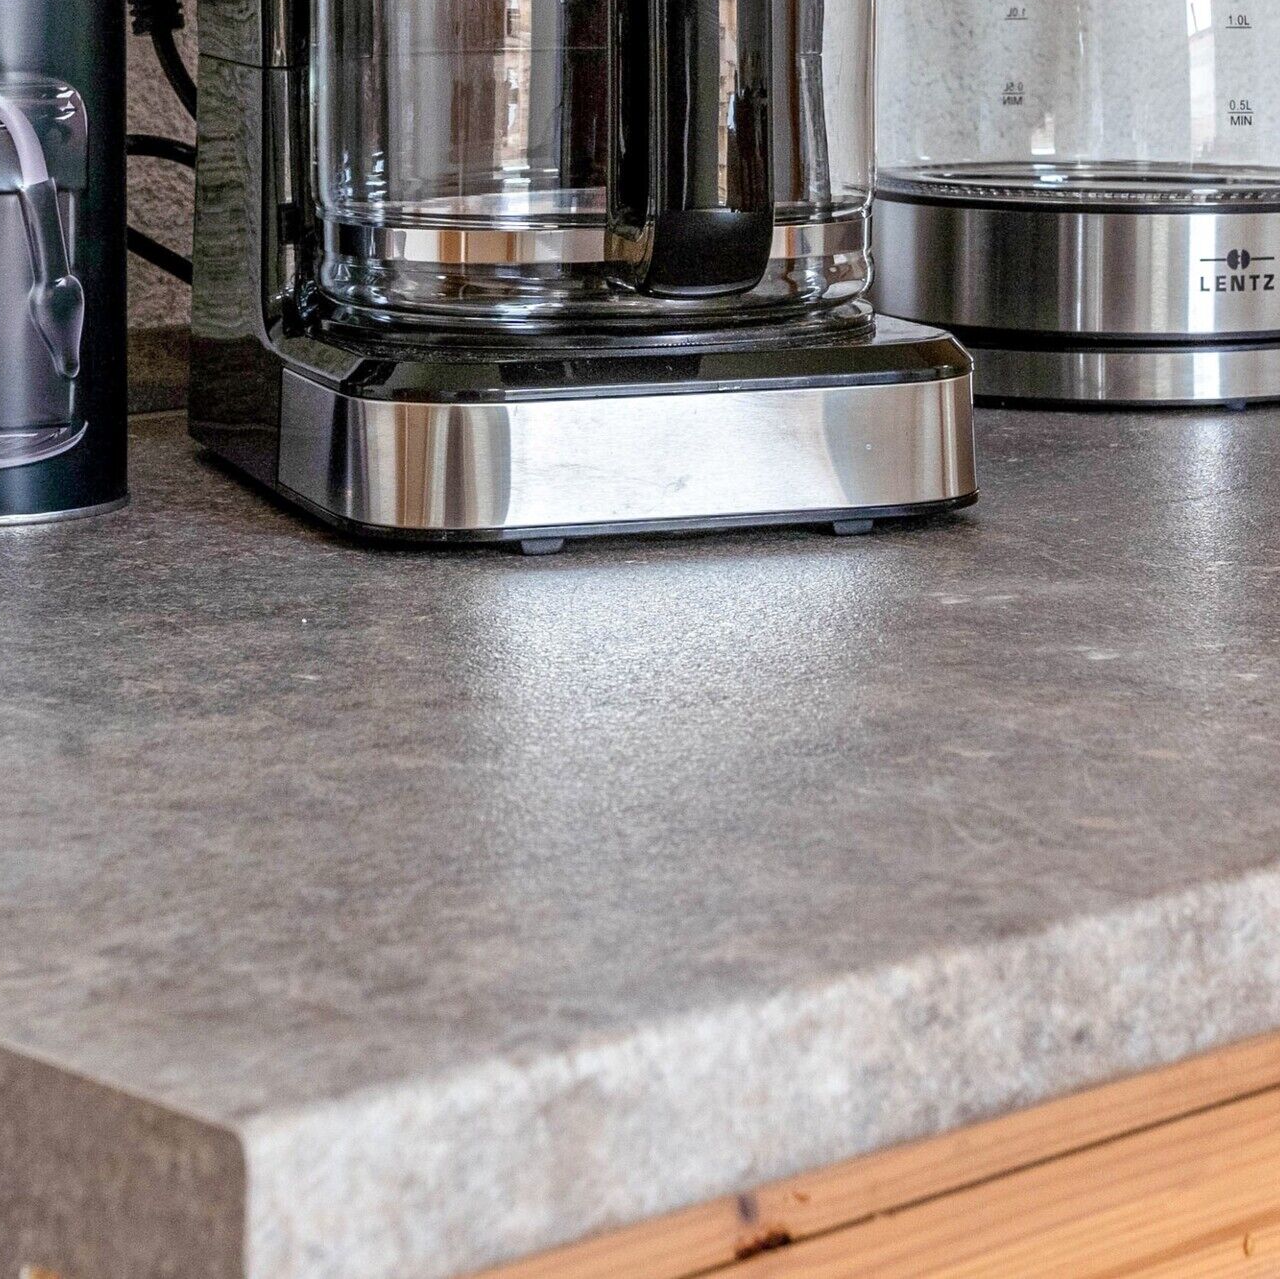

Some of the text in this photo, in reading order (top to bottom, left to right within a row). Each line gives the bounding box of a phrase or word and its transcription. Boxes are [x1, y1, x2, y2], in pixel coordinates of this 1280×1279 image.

[1229, 15, 1250, 25] 1.0L
[1229, 100, 1252, 111] 0.5L
[1230, 116, 1253, 126] MIN
[1200, 274, 1275, 292] LENTZ
